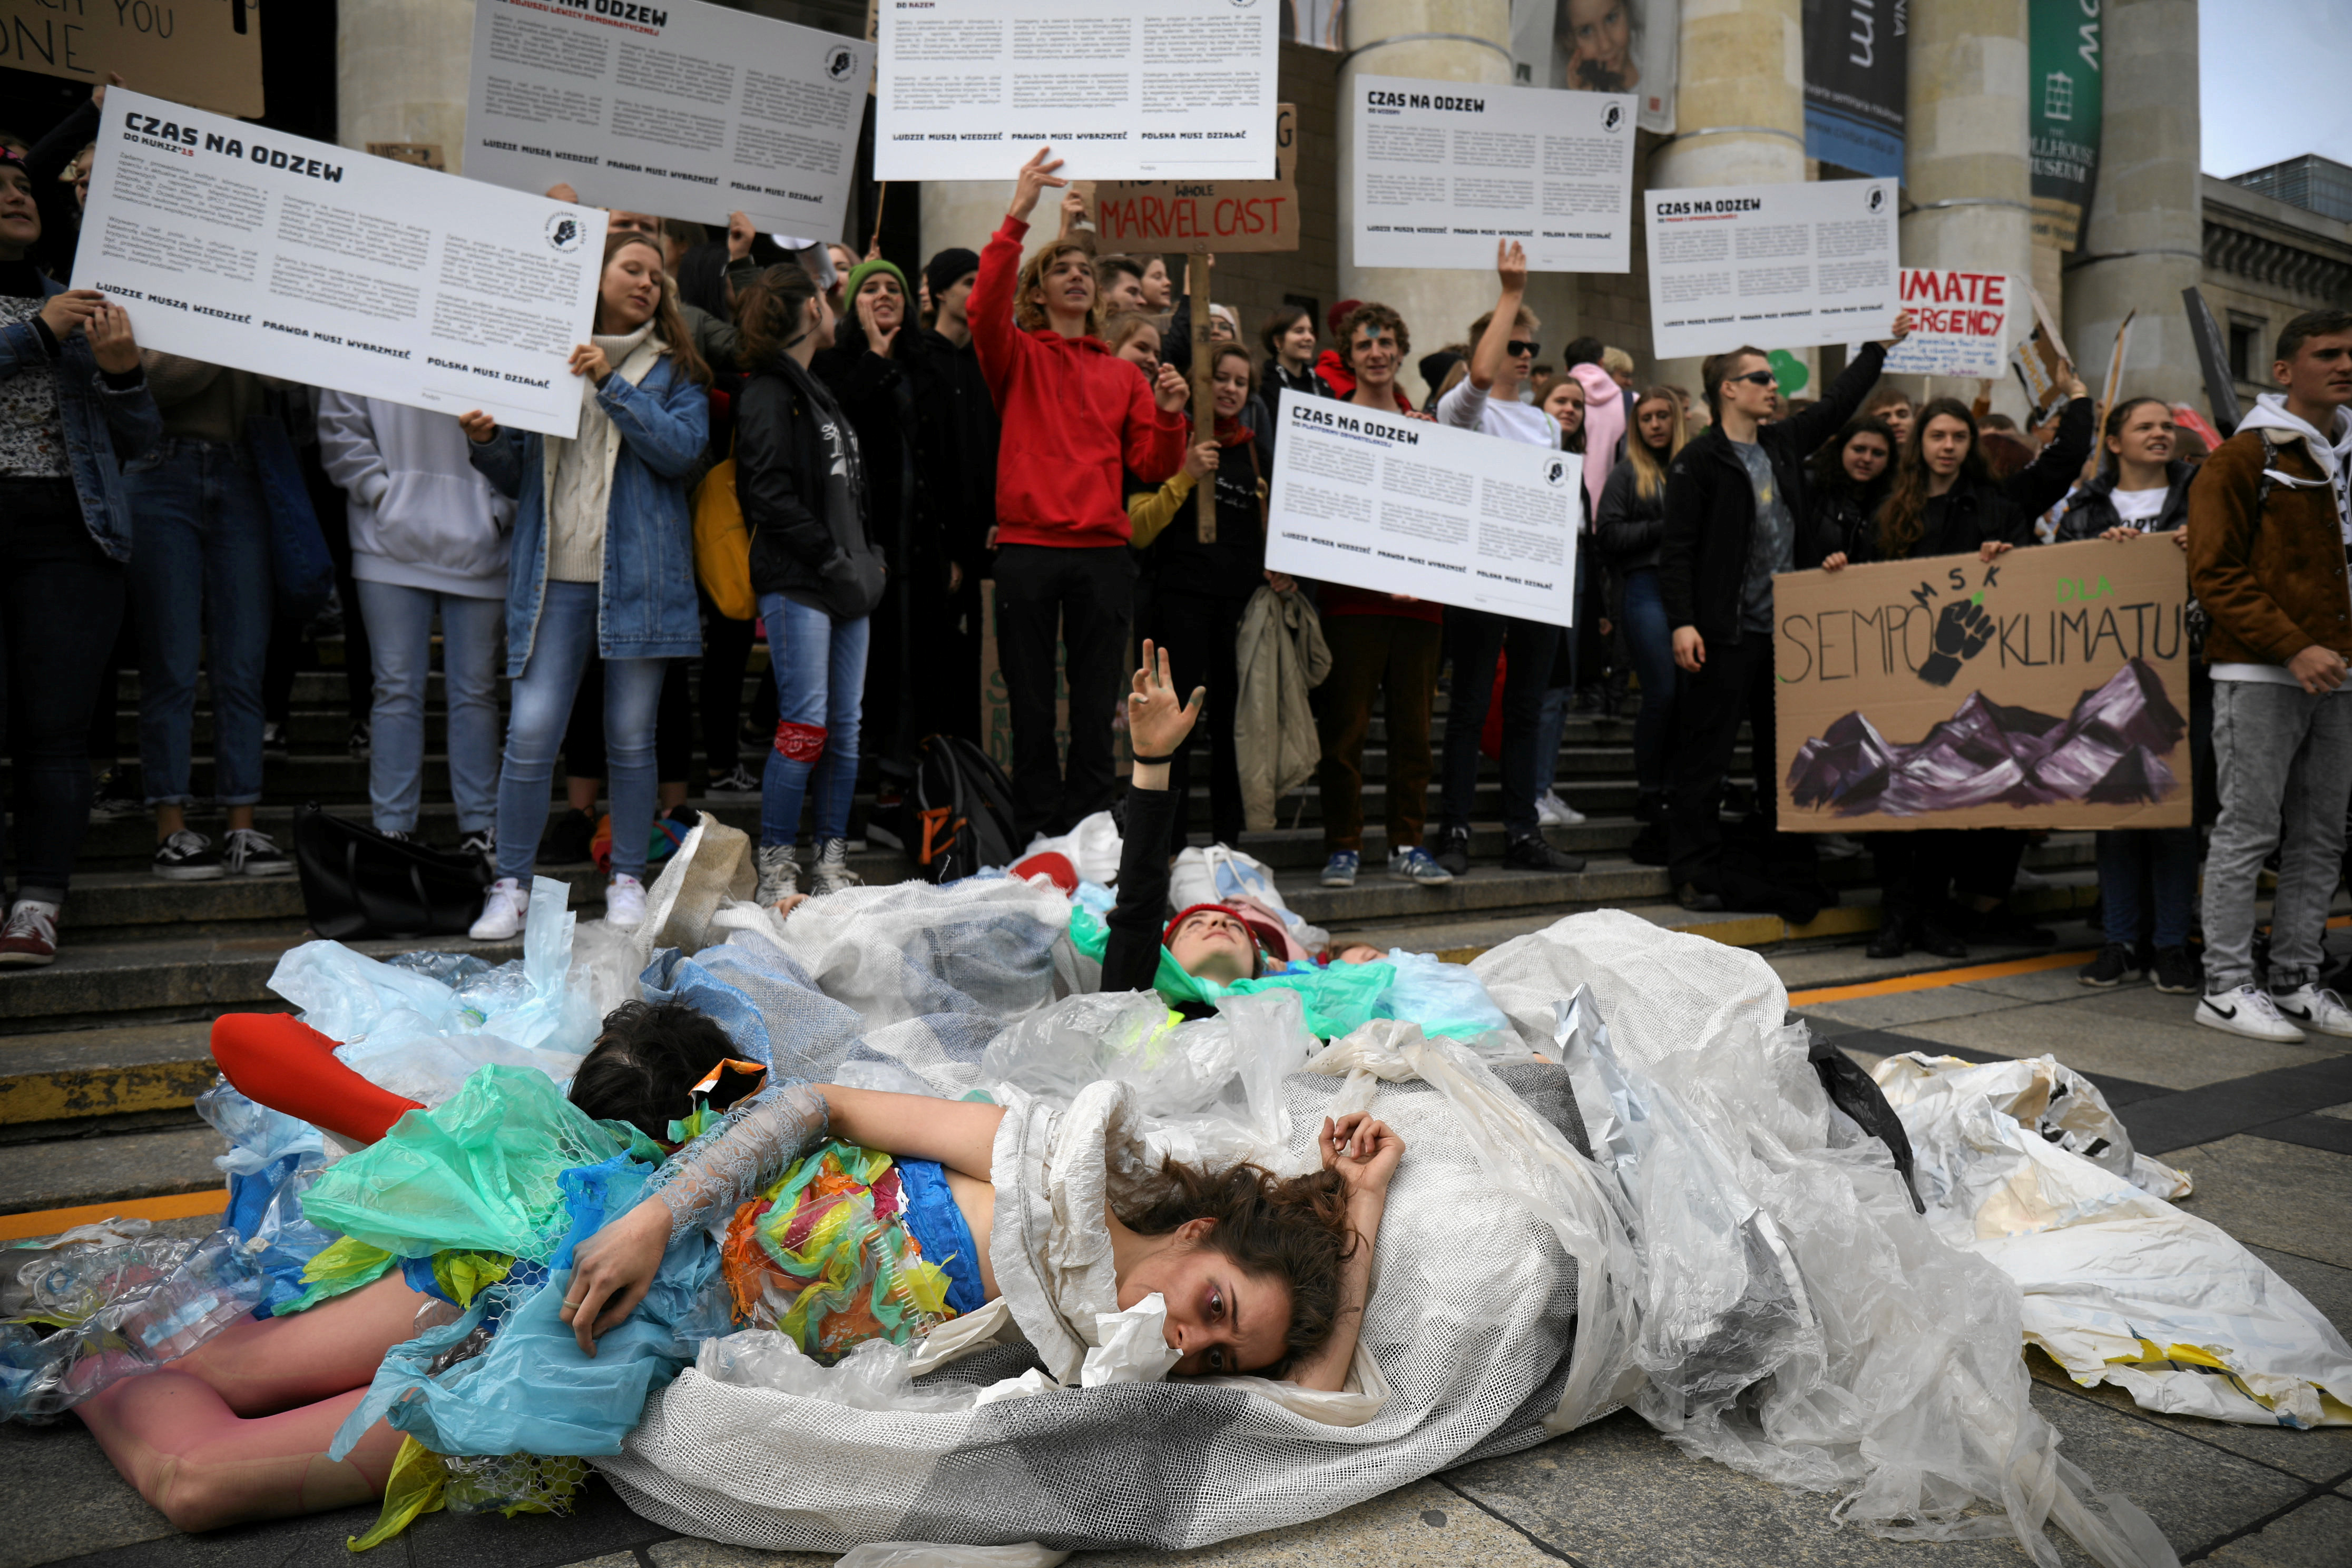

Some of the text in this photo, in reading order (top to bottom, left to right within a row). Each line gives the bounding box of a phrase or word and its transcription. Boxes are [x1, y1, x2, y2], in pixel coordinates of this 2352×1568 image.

[551, 7, 582, 19] LEWICY
[585, 14, 659, 36] DEMOKRATYCZNEJ
[595, 0, 668, 27] ODZEW
[1368, 91, 1485, 112] CZAS NA ODZEW
[123, 132, 139, 142] DO
[125, 112, 343, 183] CZAS NA ODZEW
[928, 133, 957, 142] MUSZĄ
[961, 132, 1003, 141] WIEDZIEĆ
[1076, 131, 1128, 140] WYBRZMIEĆ
[1207, 131, 1247, 139] DZIAŁAĆ
[483, 138, 822, 203] LUDZIE MUSZĄ WIEDZIEĆ PRAWDA MUSI WYBRZMIEĆ POLSKA MUSI DZIAŁAĆ
[1175, 184, 1214, 197] WHOLE
[1100, 196, 1286, 239] MARVEL CAST
[1657, 198, 1760, 215] CZAS NA ODZEW
[96, 282, 551, 389] LUDZIE MUSZĄ WIEDZIEĆ PRAWDA MUSI WYBRZMIEĆ POLSKA MUSI DZIAŁAĆ
[1292, 406, 1419, 445] CZAS NA ODZEW
[1282, 531, 1309, 543] LUDZIE
[1377, 551, 1405, 562] PRAWDA
[1408, 557, 1425, 566] MUSI
[1477, 570, 1502, 581] POLSKA
[1505, 575, 1522, 584] MUSI
[2056, 574, 2114, 604] DLA
[1999, 603, 2182, 669] KLIMATU
